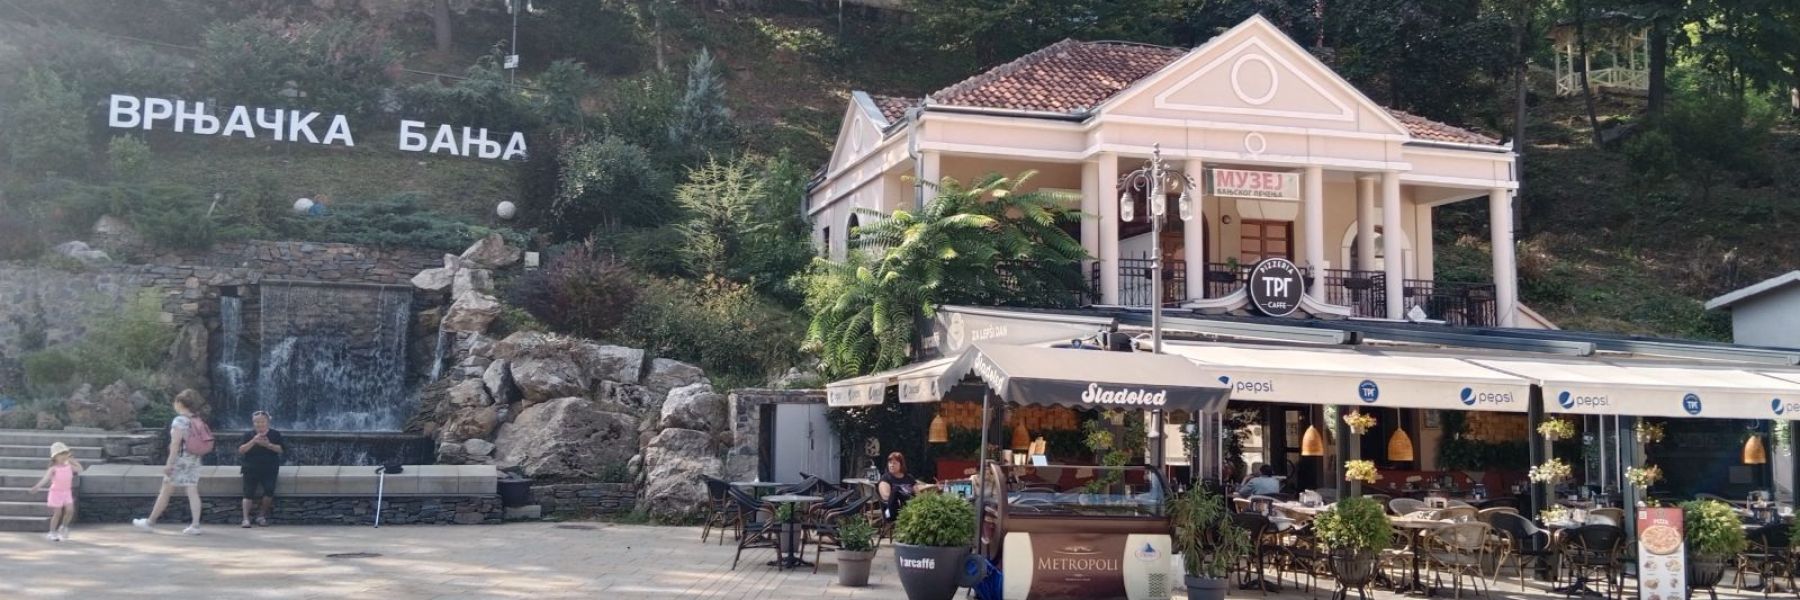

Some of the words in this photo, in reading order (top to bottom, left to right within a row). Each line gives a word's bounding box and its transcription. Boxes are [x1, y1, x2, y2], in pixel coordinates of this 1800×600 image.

[109, 94, 354, 147] ВРЊАЧКА
[399, 119, 528, 161] БАЊА
[1216, 170, 1283, 191] МУЗЕЈ
[1260, 260, 1293, 274] PIZZERIA
[1262, 276, 1293, 298] ТРГ
[1236, 380, 1274, 394] pepsi
[1081, 383, 1167, 406] Sladoled
[1478, 391, 1514, 405] pepsi
[1576, 394, 1609, 407] pepsi
[1038, 557, 1118, 571] METROPOLI
